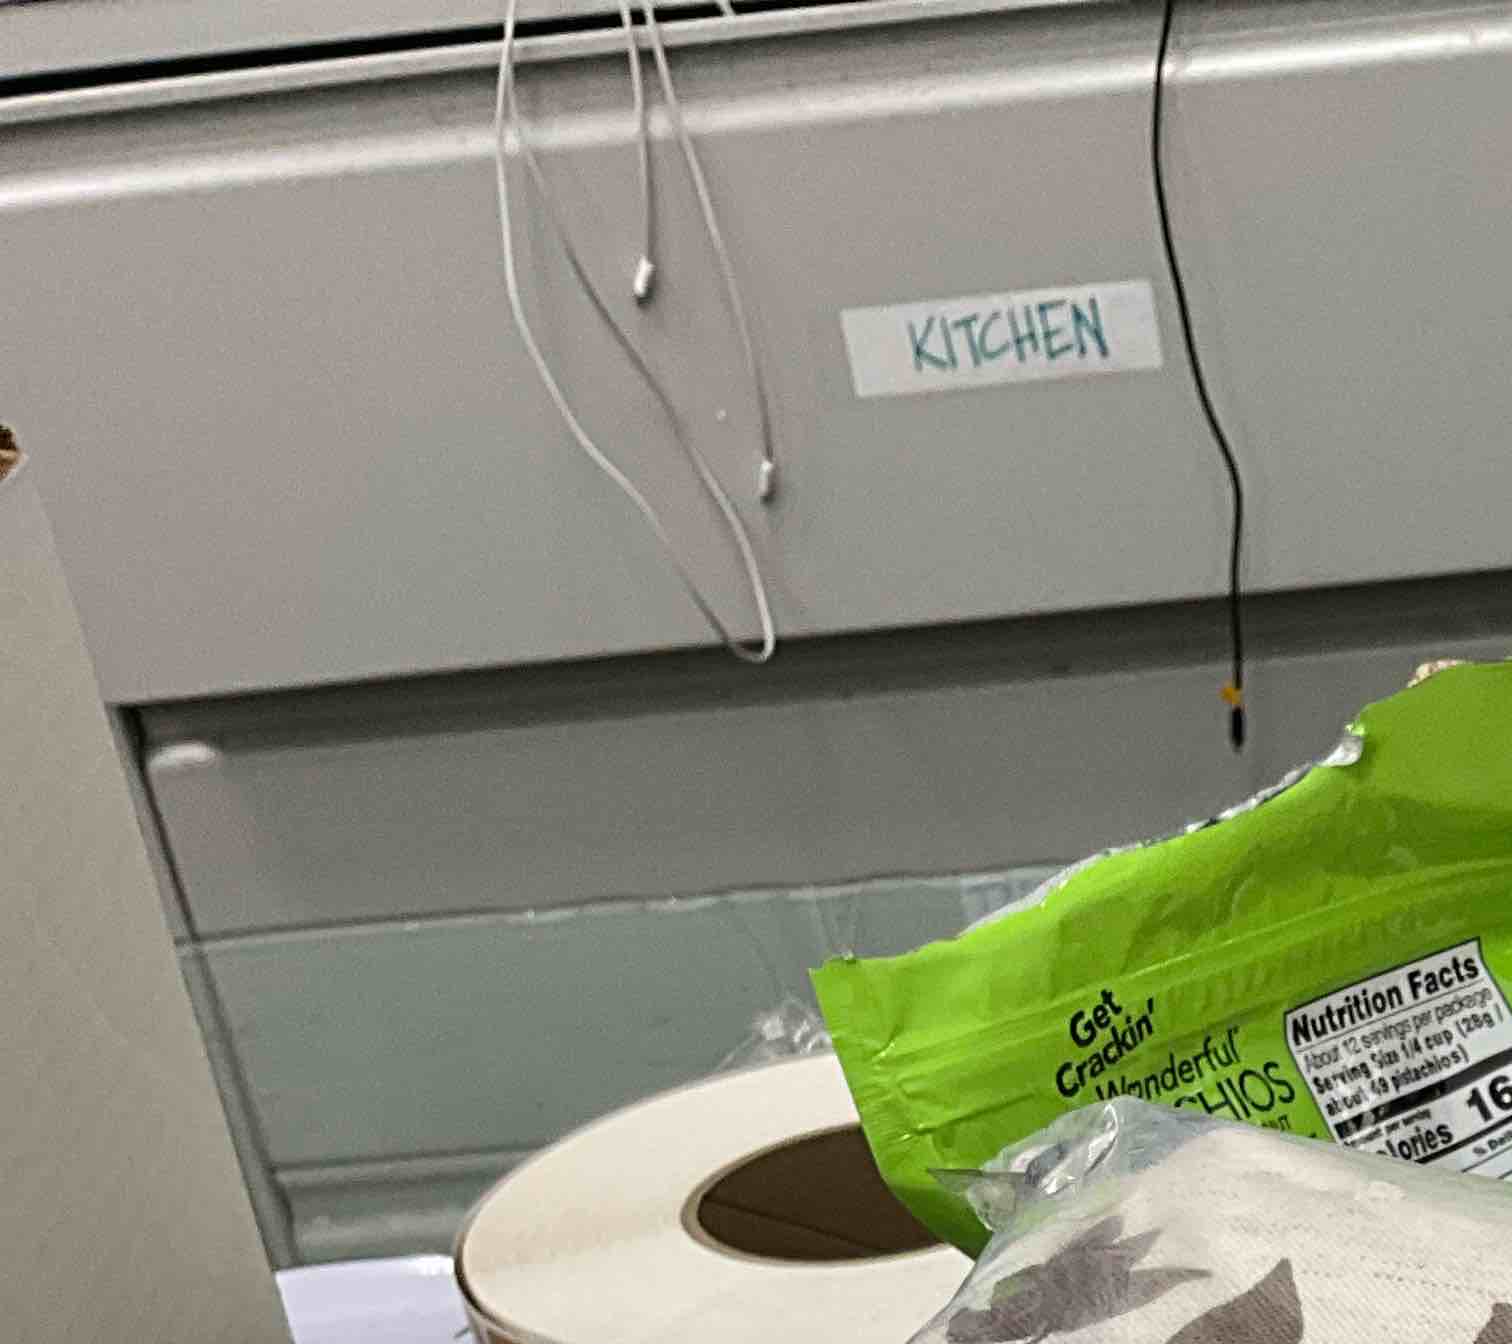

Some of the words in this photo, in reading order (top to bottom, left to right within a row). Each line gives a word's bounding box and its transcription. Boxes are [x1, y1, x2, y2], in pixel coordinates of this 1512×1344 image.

[906, 296, 1110, 373] KITCHEN
[1068, 988, 1123, 1049] Get
[1290, 987, 1404, 1047] Nutrition
[1406, 955, 1481, 1001] Facts
[1434, 986, 1494, 1027] package
[1055, 998, 1155, 1098] Crackin'
[1311, 1060, 1372, 1096] Serving
[1400, 1038, 1424, 1062] 1/4
[1424, 1030, 1456, 1055] cup
